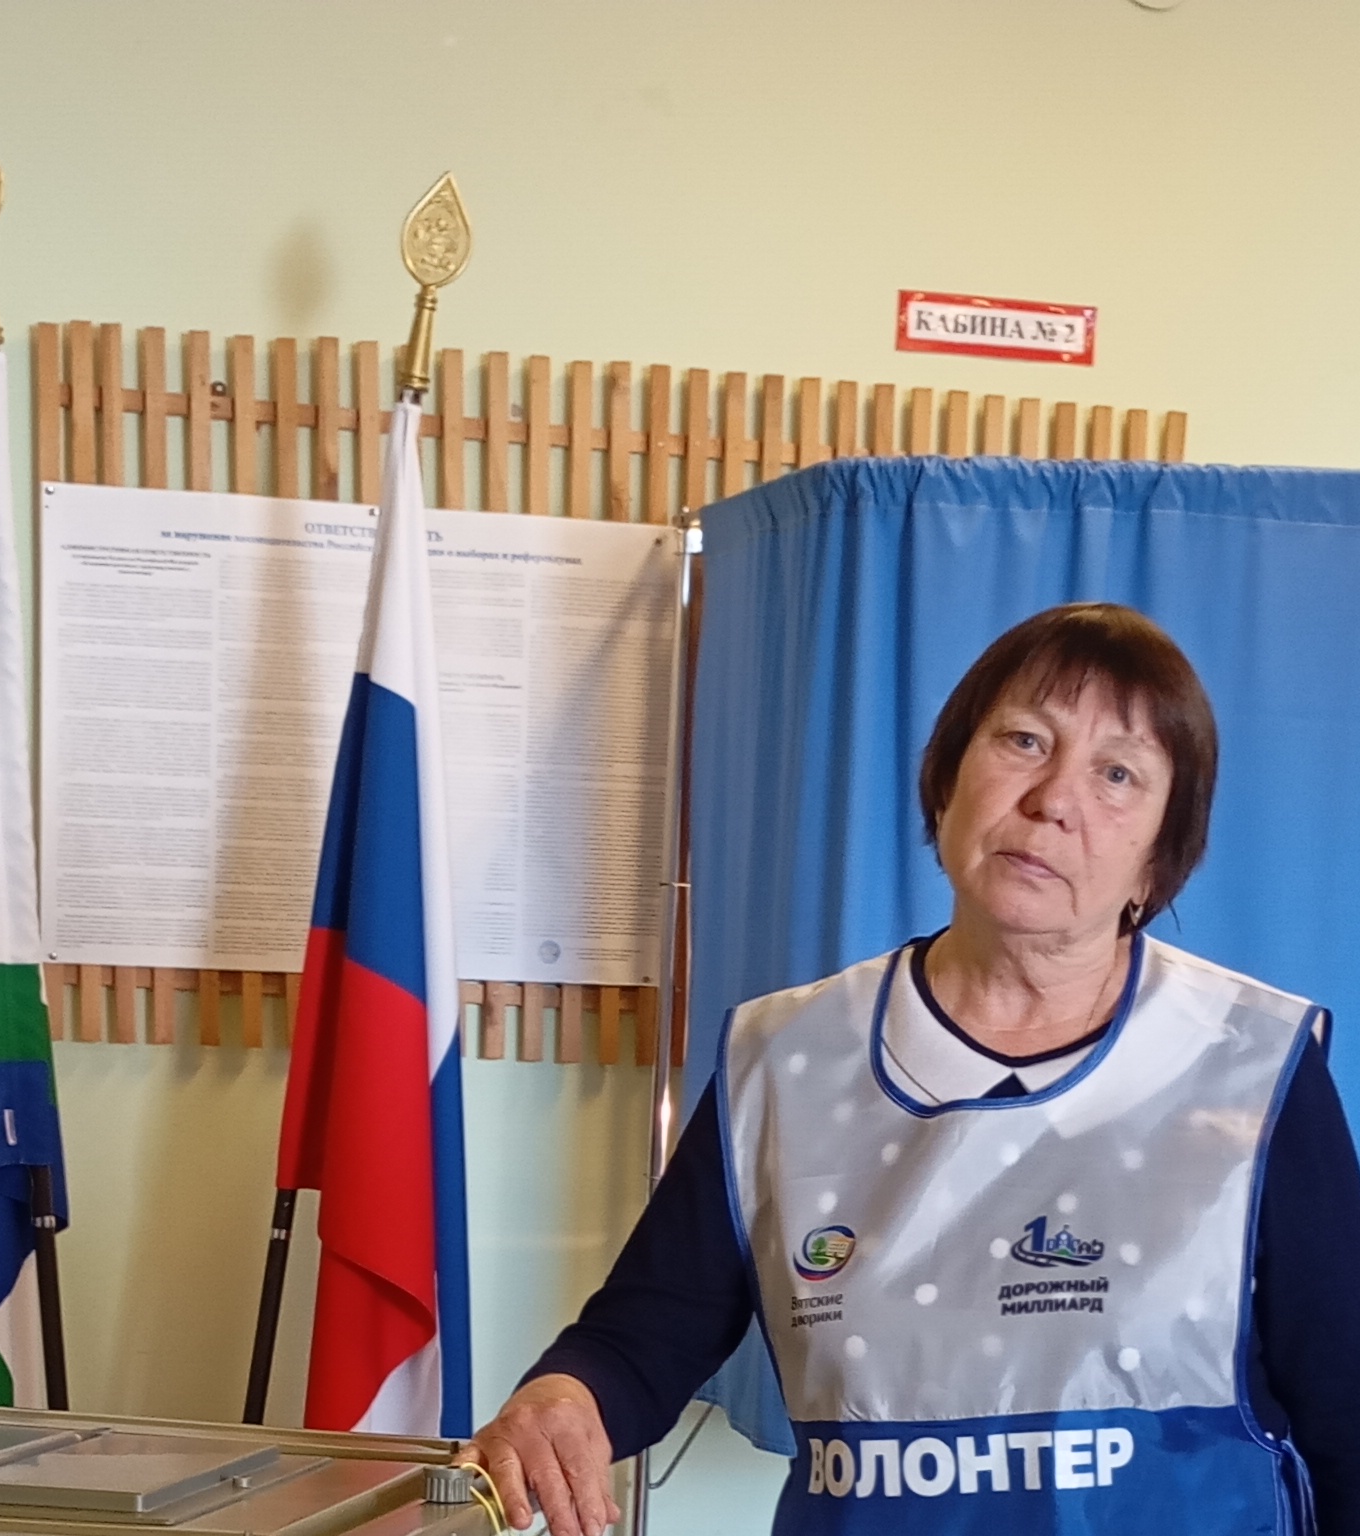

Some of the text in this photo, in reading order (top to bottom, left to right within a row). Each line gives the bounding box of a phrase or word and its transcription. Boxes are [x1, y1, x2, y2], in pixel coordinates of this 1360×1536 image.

[914, 309, 1077, 344] КАБИНА № 2
[997, 1276, 1110, 1301] ДОРОЖНЫЙ
[1000, 1297, 1104, 1316] МИЛЛИАРД
[807, 1427, 1135, 1499] ВОЛОНТЕР
